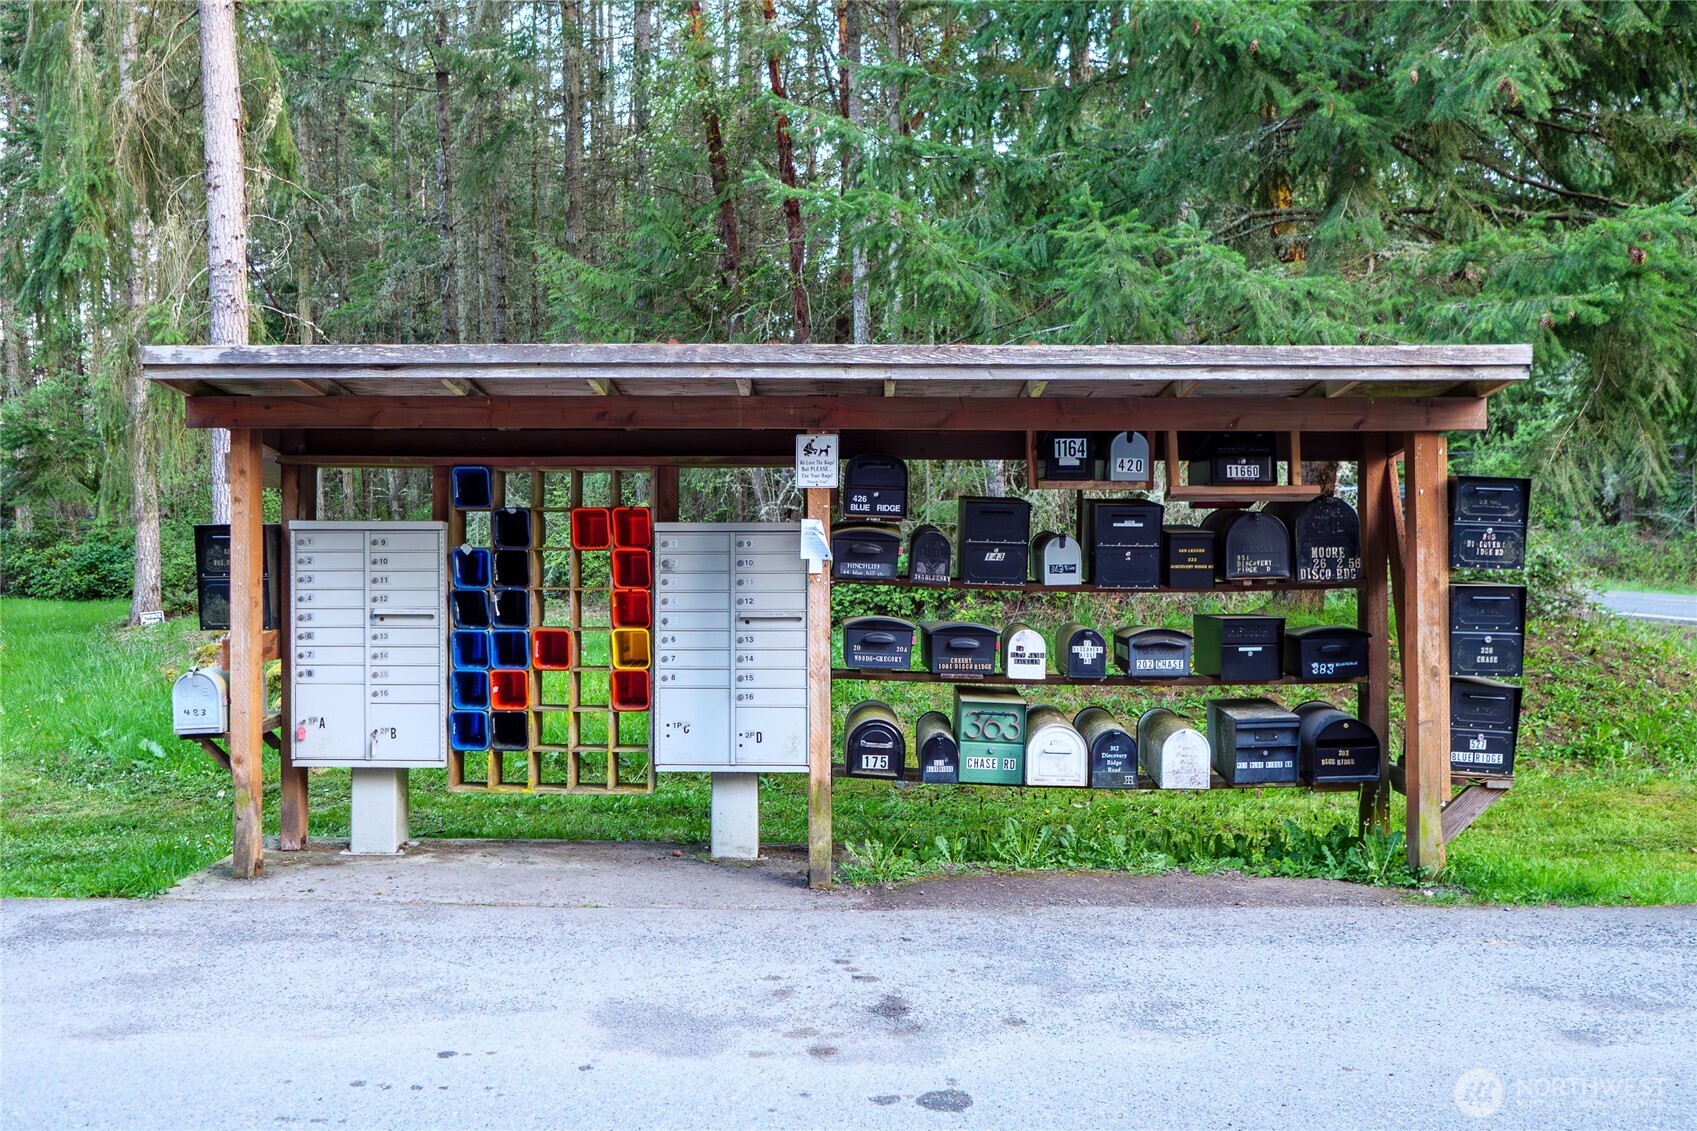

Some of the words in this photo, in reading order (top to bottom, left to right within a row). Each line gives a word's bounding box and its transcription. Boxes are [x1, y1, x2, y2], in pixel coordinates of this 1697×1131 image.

[1055, 440, 1086, 457] 1164
[1118, 459, 1143, 472] 420
[1228, 465, 1259, 477] 11660
[852, 495, 867, 503] 426
[850, 503, 870, 511] BLUE
[876, 504, 901, 512] RIDGE
[985, 552, 1005, 561] 143
[1311, 547, 1346, 559] MOORE
[1300, 569, 1332, 580] DISCO
[1336, 568, 1357, 580] RDG
[854, 655, 903, 663] WOODS-GREGORY
[1137, 660, 1153, 669] 202
[1156, 660, 1183, 669] CHASE
[745, 693, 754, 701] 16
[319, 717, 326, 728] A
[964, 710, 1020, 740] 363
[390, 727, 397, 739] B
[756, 731, 763, 743] D
[1471, 740, 1486, 750] 527
[864, 756, 887, 768] 175
[1336, 758, 1355, 766] RIDGE
[1451, 752, 1472, 761] BLUE
[1475, 753, 1502, 763] RIDGE
[967, 758, 997, 769] CHASE
[1003, 759, 1015, 769] RD
